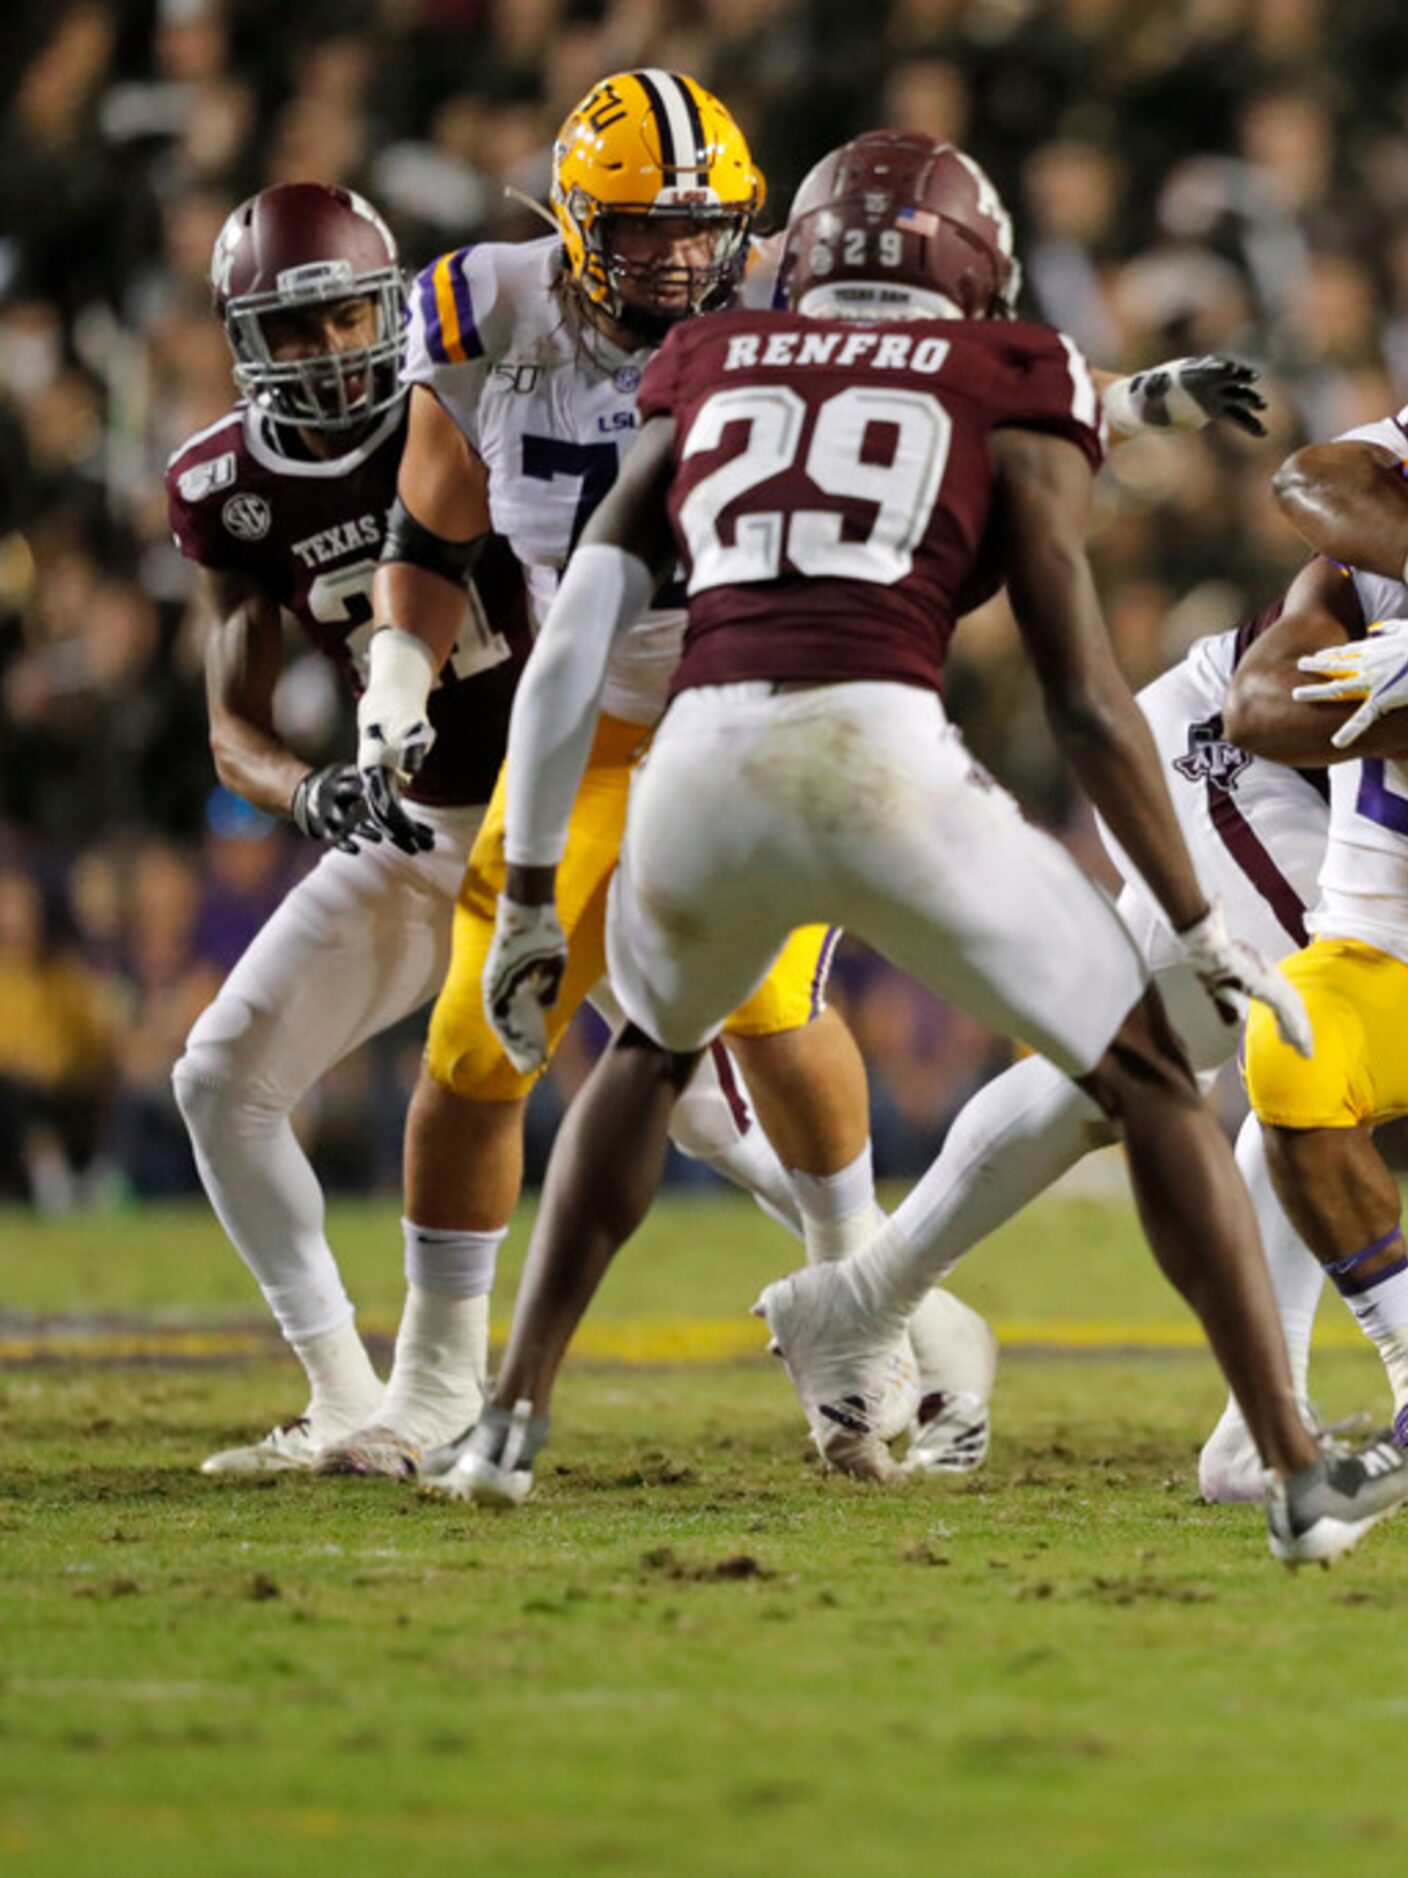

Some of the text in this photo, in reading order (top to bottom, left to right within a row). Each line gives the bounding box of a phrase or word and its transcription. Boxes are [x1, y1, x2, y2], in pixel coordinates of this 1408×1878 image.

[844, 228, 902, 267] 29
[722, 333, 951, 374] RENFRO
[680, 384, 953, 597] 29
[291, 513, 382, 569] TEXAS
